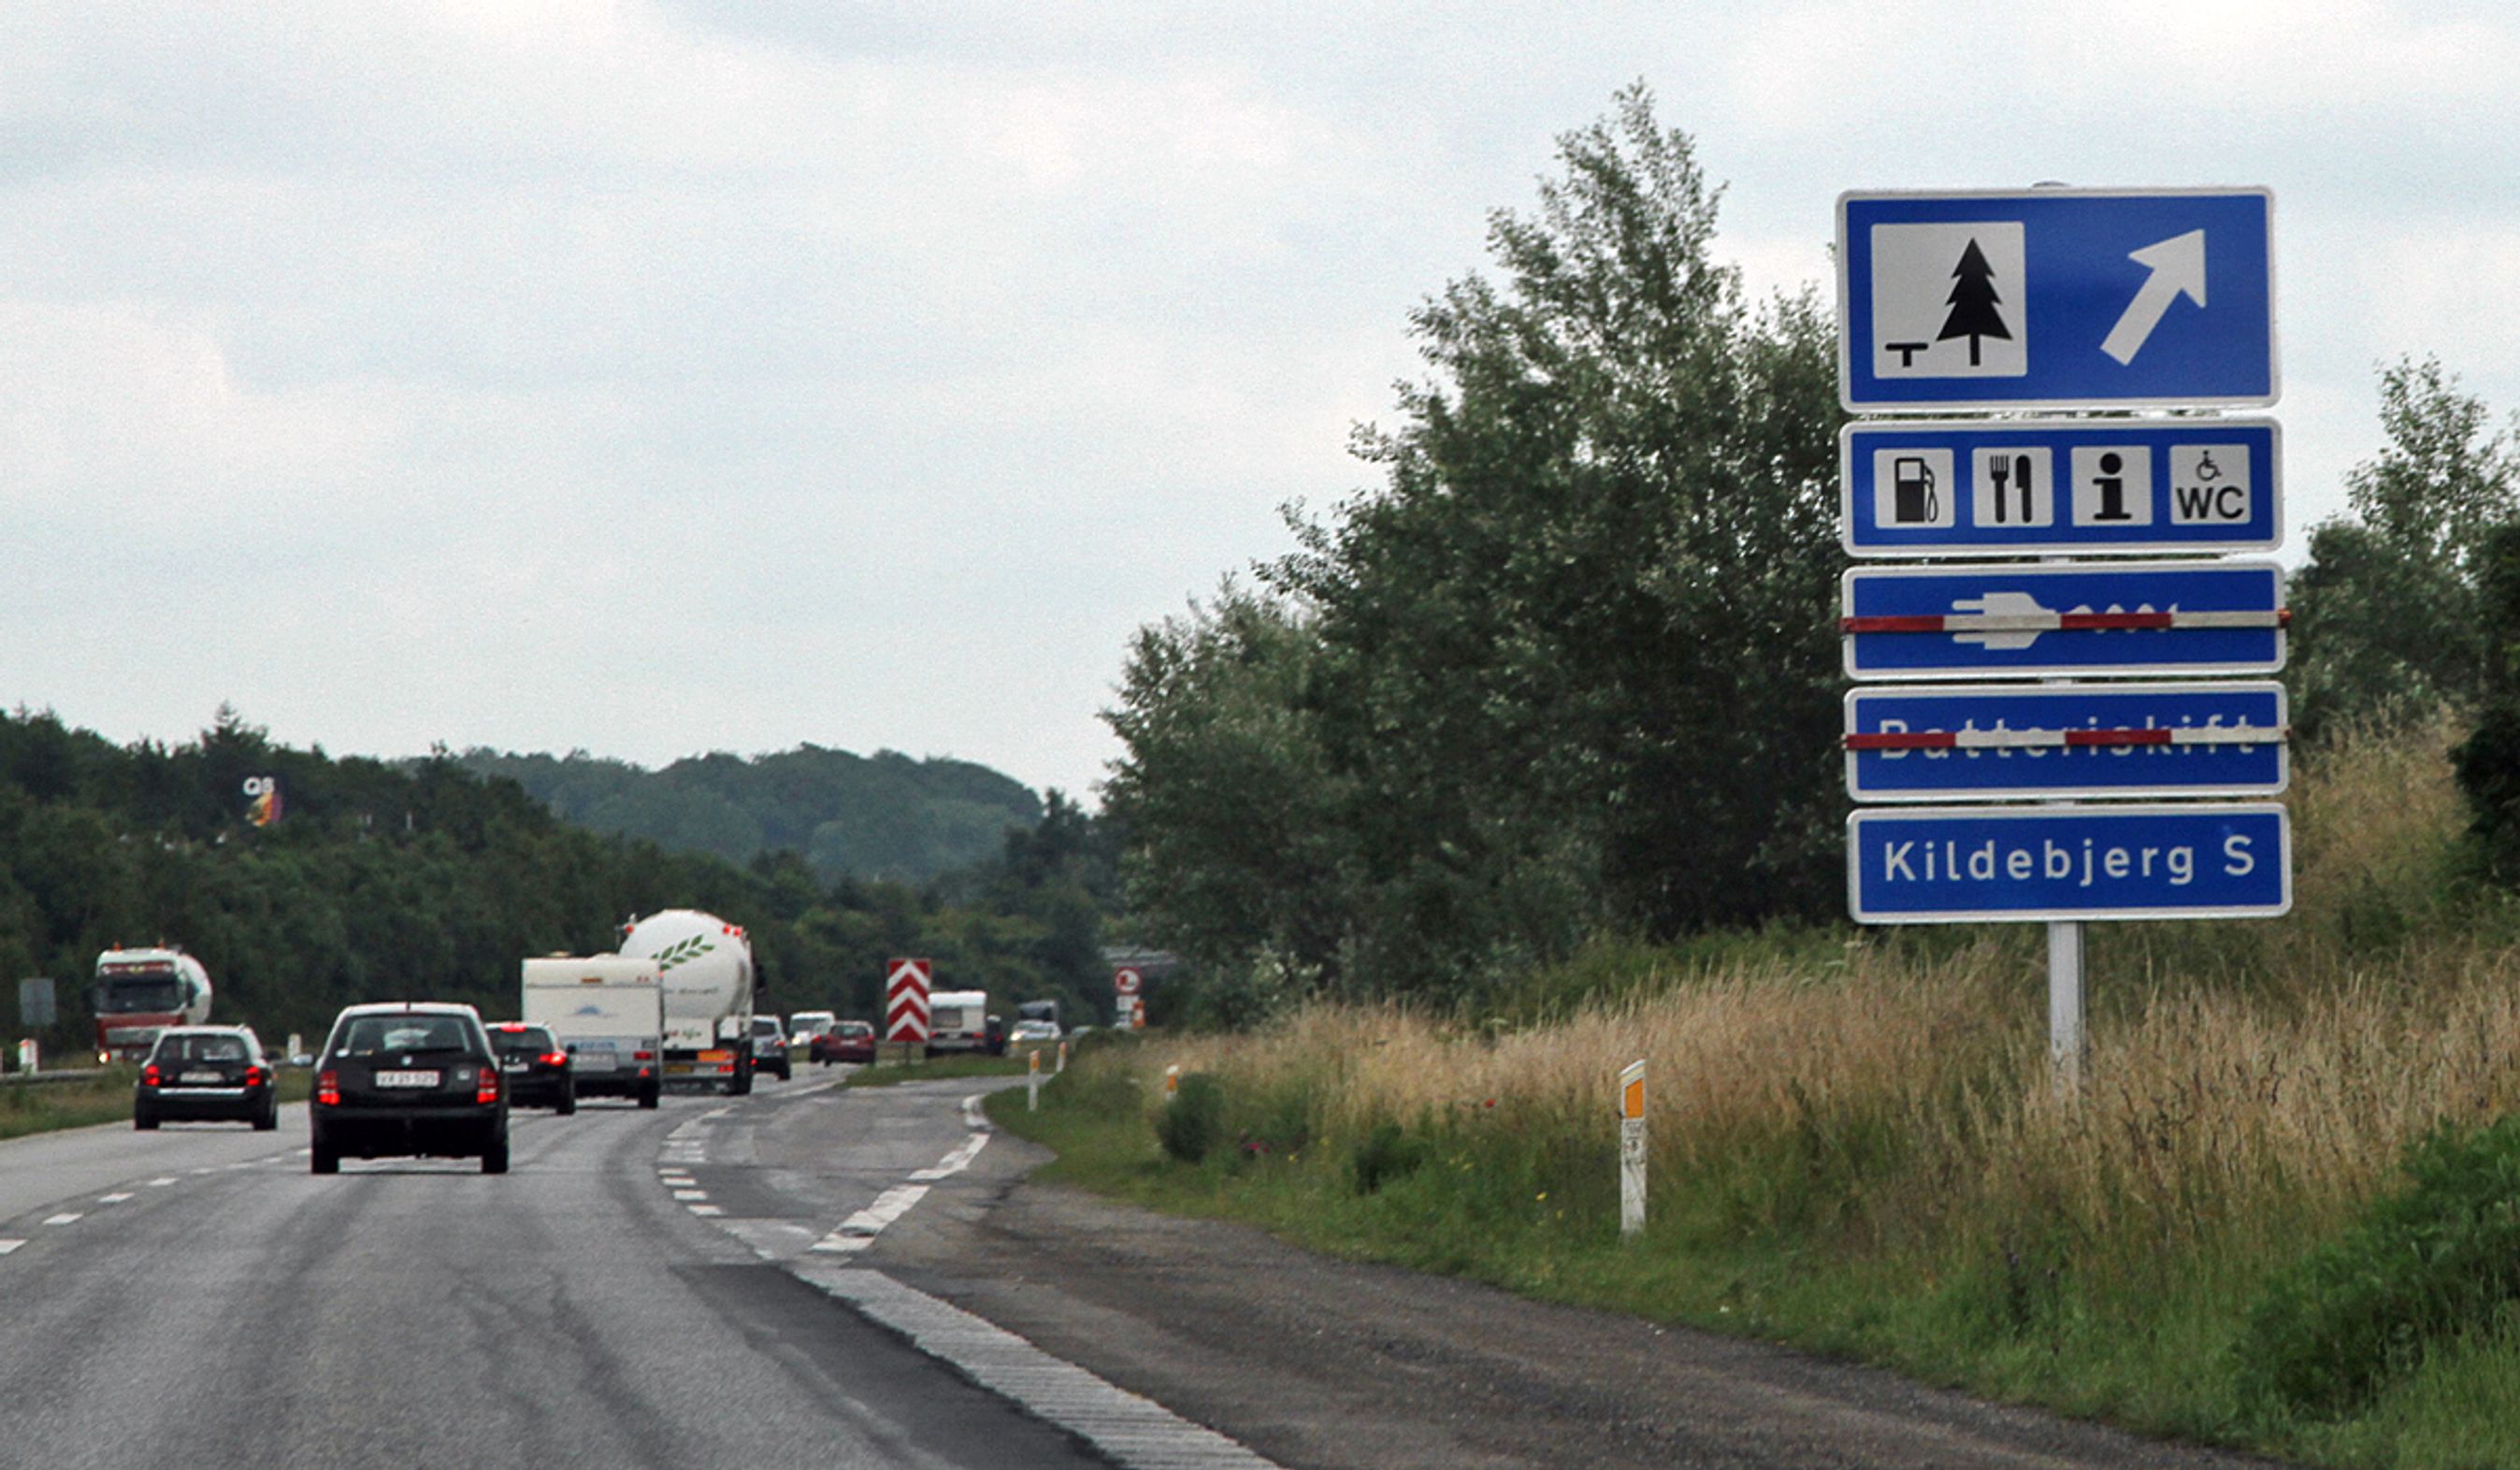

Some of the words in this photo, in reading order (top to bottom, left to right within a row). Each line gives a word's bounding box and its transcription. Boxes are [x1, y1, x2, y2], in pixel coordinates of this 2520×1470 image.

[2176, 485, 2244, 520] WC
[1884, 838, 2194, 887] Kildebjerg
[2224, 835, 2254, 876] S
